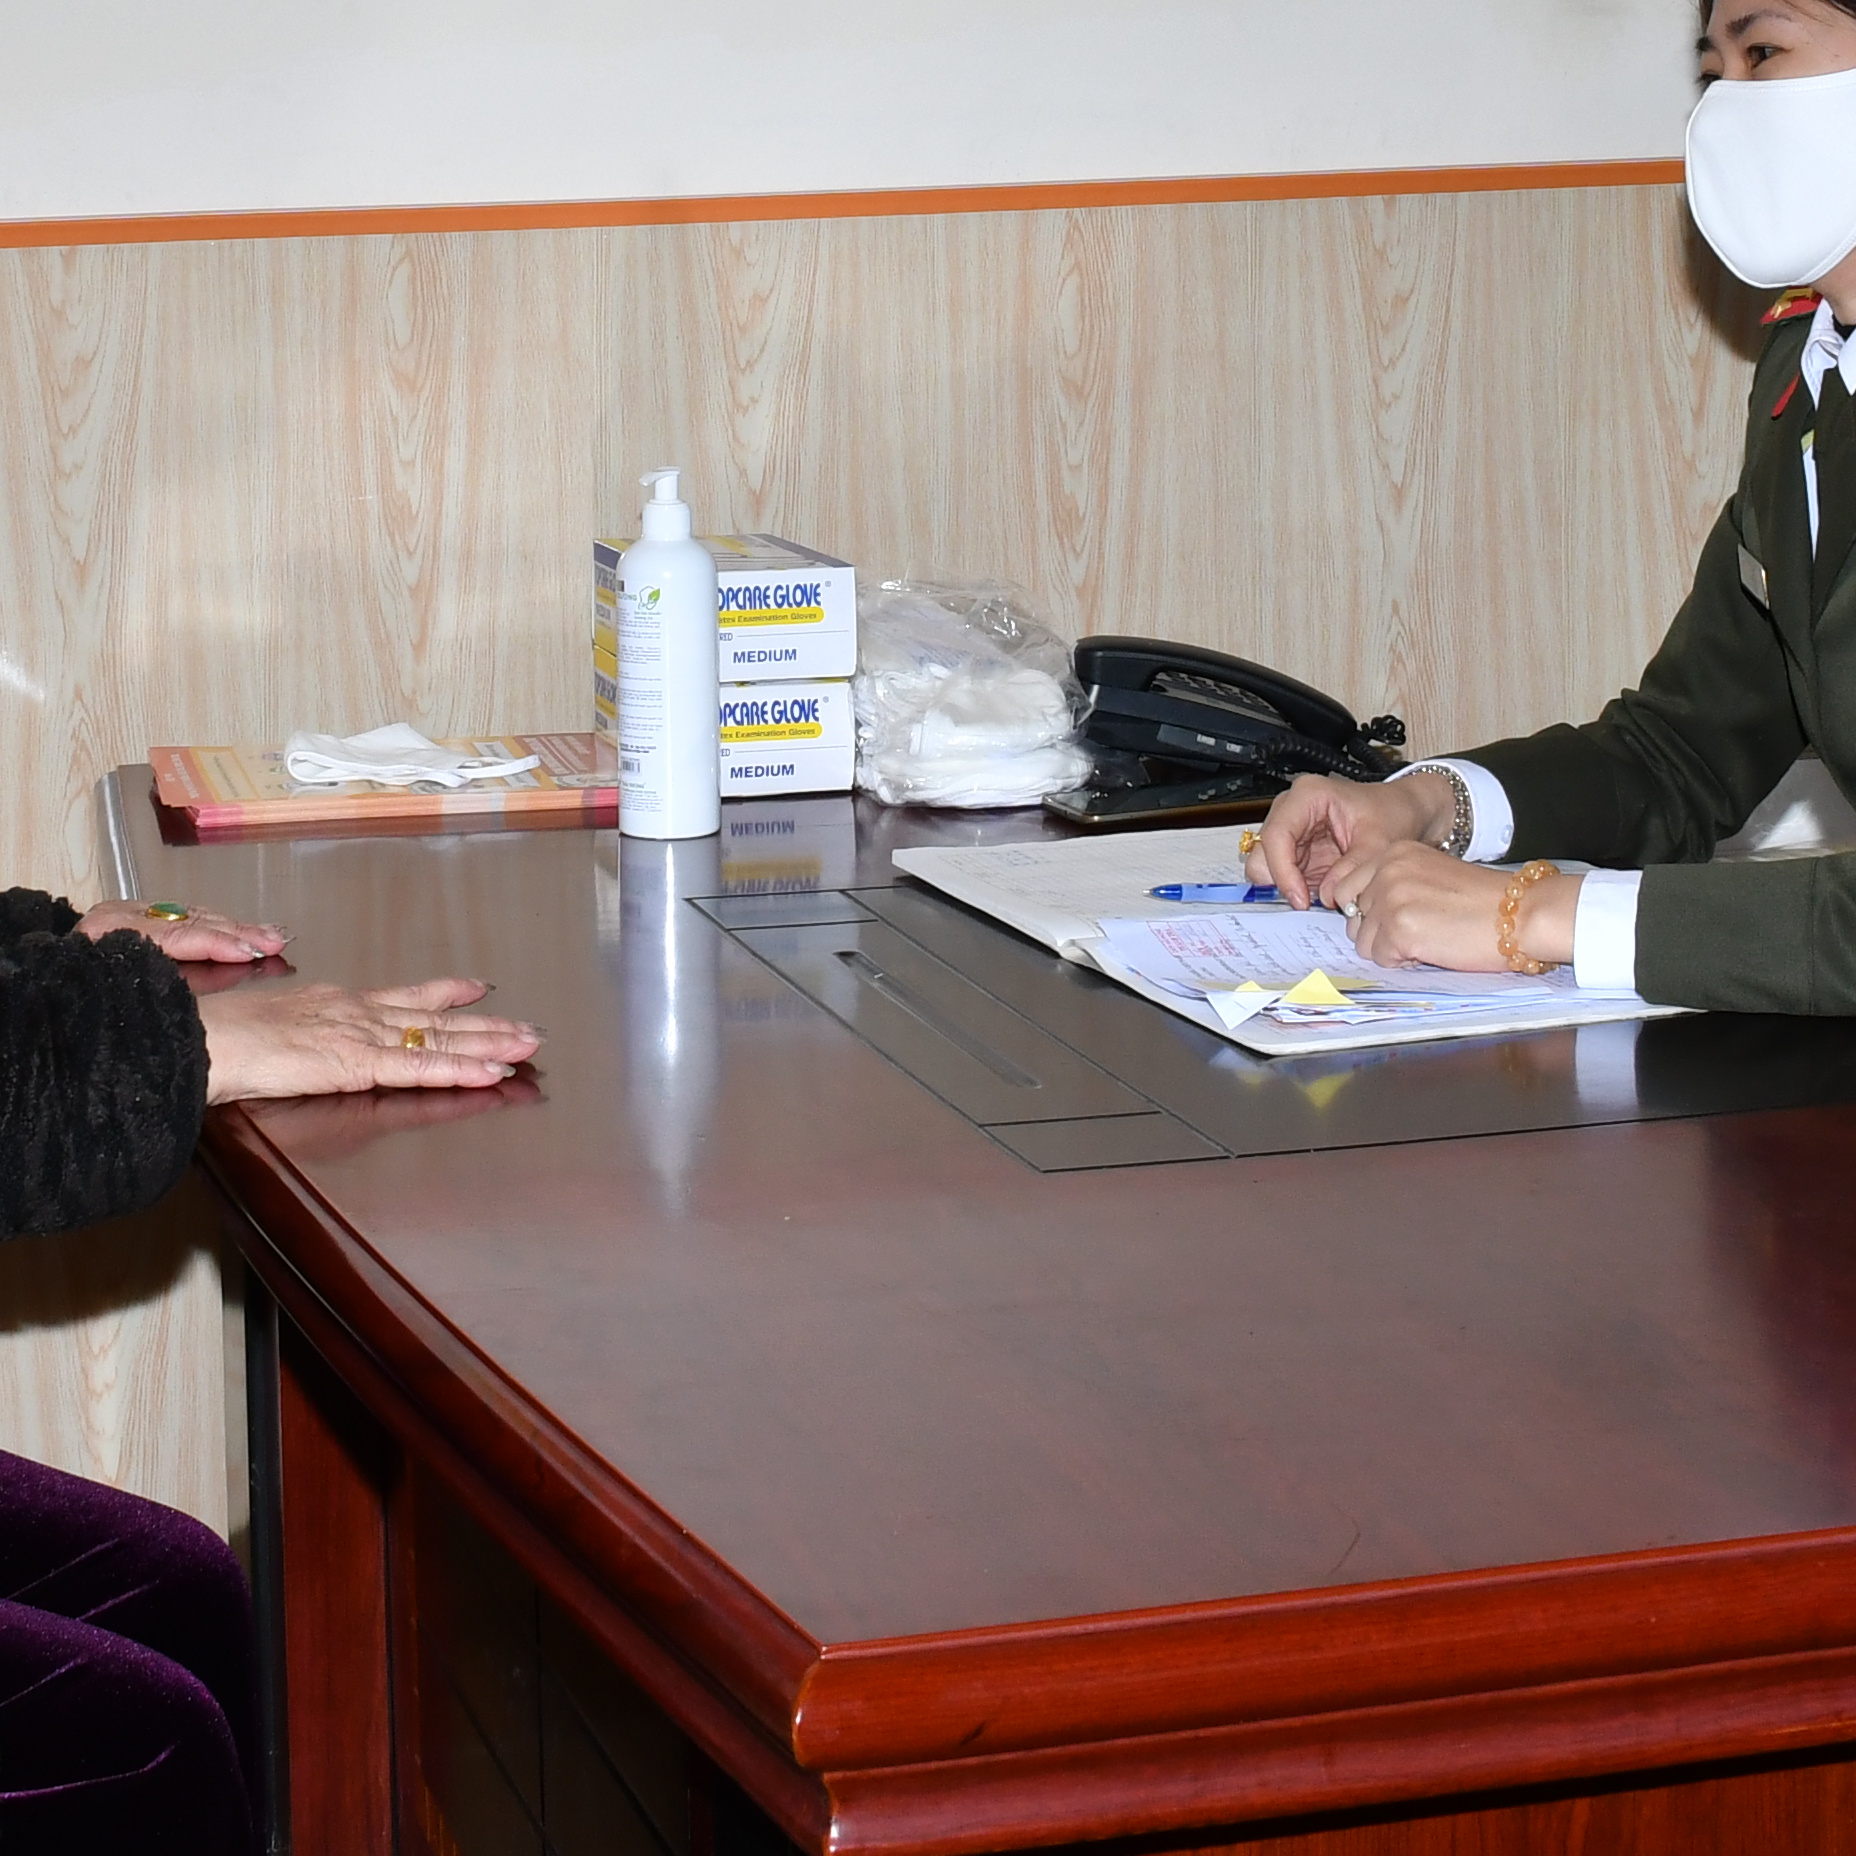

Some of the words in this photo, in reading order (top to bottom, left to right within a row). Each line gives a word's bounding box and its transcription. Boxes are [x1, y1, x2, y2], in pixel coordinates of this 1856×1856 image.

[773, 582, 822, 609] GLOVE
[732, 648, 797, 664] MEDIUM
[770, 698, 820, 724] GLOVE
[729, 763, 795, 779] MEDIUM
